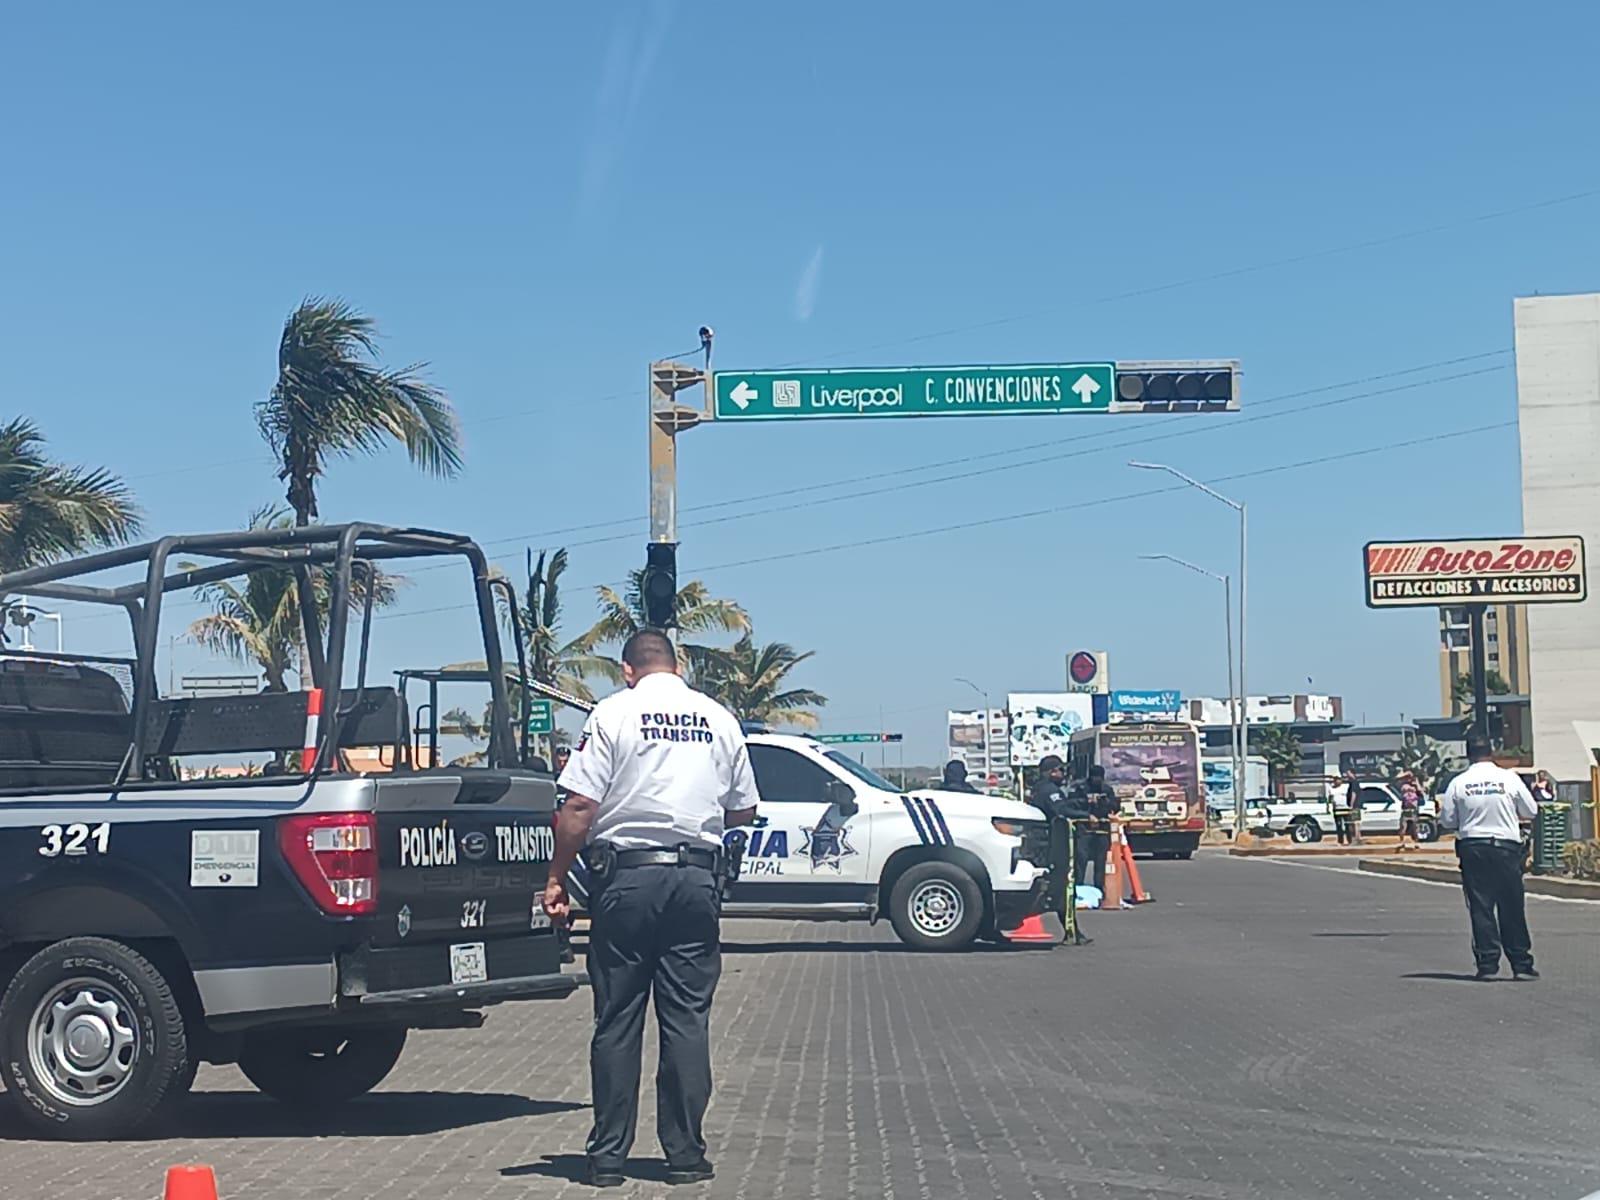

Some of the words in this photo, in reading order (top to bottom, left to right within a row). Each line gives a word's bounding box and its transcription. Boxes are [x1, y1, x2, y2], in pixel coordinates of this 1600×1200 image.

[811, 384, 903, 412] Liverpool
[925, 377, 939, 404] C.
[945, 375, 1061, 404] CONVENCIONES
[1416, 544, 1577, 574] AutoZone
[1376, 580, 1473, 597] REFACCIONES
[1476, 580, 1488, 593] Y
[1491, 577, 1576, 594] ACCESORIOS
[641, 711, 710, 729] POLICÍA
[38, 822, 111, 857] 321
[400, 819, 457, 867] POLICÍA
[495, 821, 556, 863] TRÁNSITO
[460, 900, 487, 928] 321
